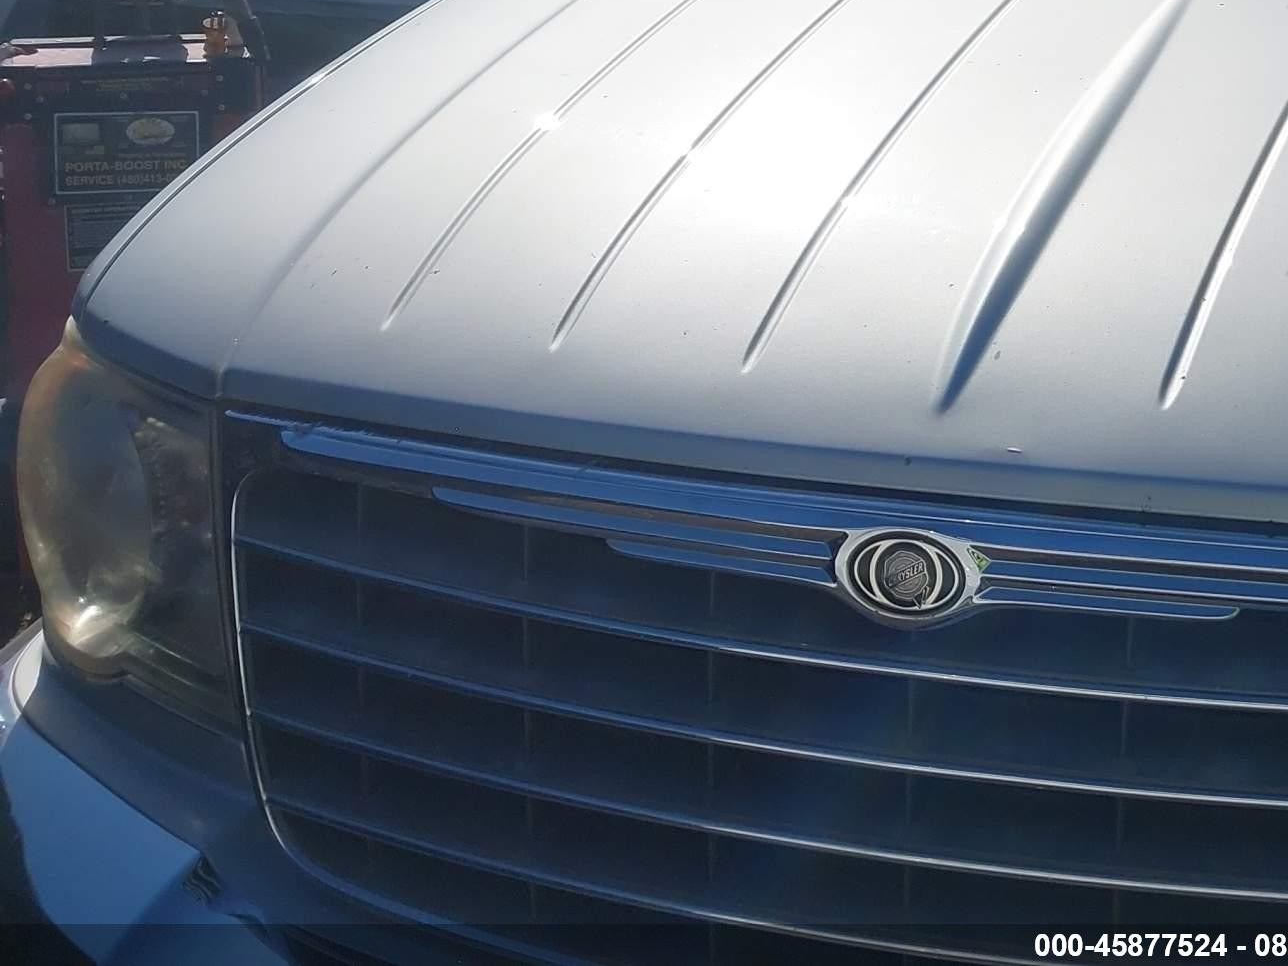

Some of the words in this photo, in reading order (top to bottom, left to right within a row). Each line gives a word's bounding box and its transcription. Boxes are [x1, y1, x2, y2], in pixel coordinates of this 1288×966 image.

[64, 160, 160, 172] PORTA-BOOST
[65, 174, 114, 186] SERVICE
[889, 562, 923, 586] RYSLER
